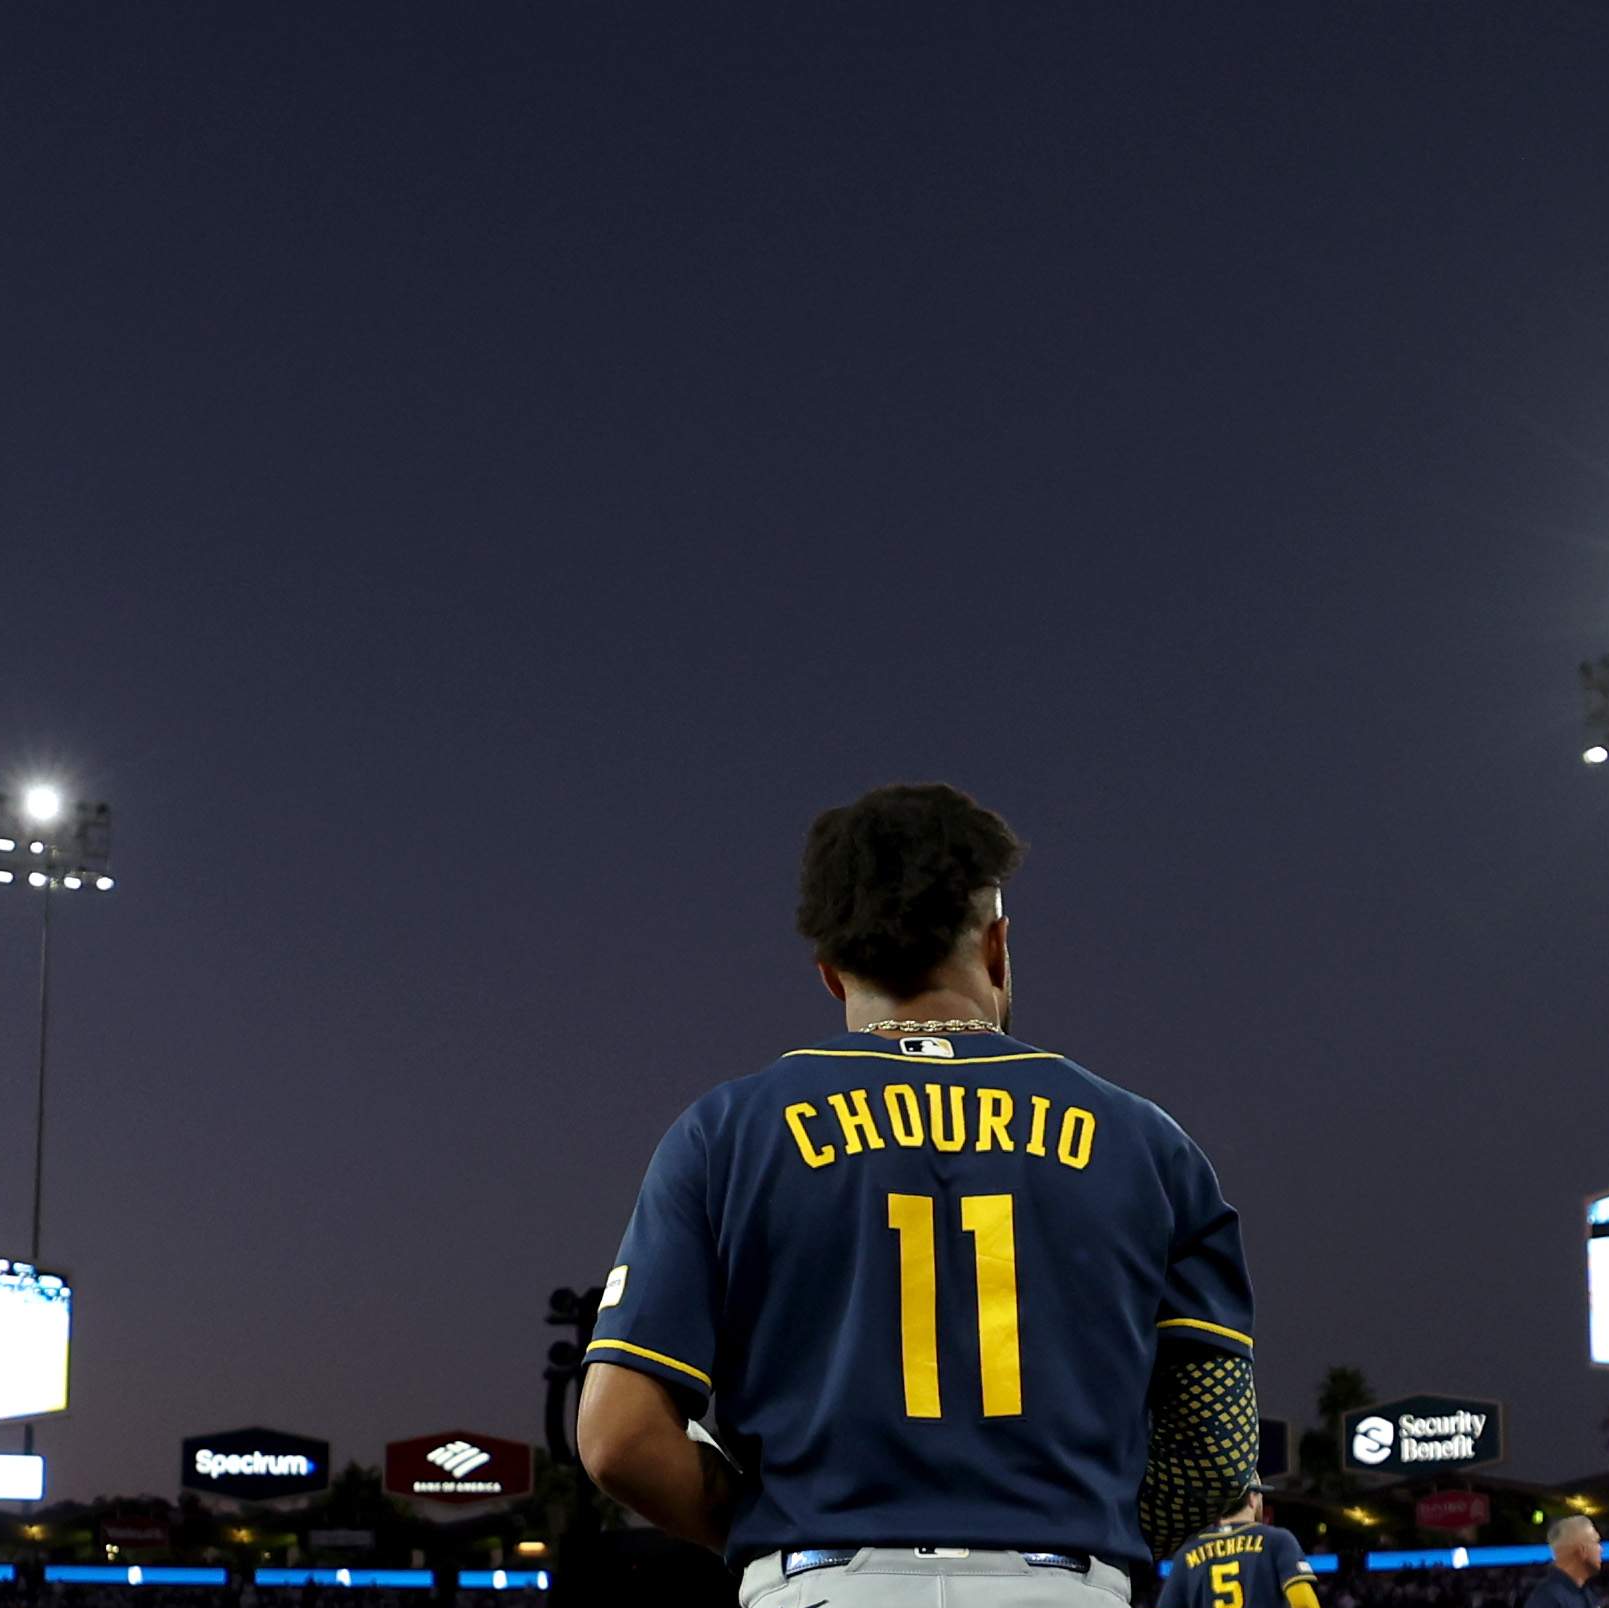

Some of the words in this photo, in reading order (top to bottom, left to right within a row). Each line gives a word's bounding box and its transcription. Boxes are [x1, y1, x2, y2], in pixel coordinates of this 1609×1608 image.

[784, 1082, 1097, 1170] CHOURIO
[887, 1193, 1023, 1420] 11
[1399, 1409, 1487, 1440] Security
[195, 1449, 309, 1479] Spectrum
[1400, 1436, 1476, 1463] Benefit
[1185, 1533, 1264, 1570] MITCHELL
